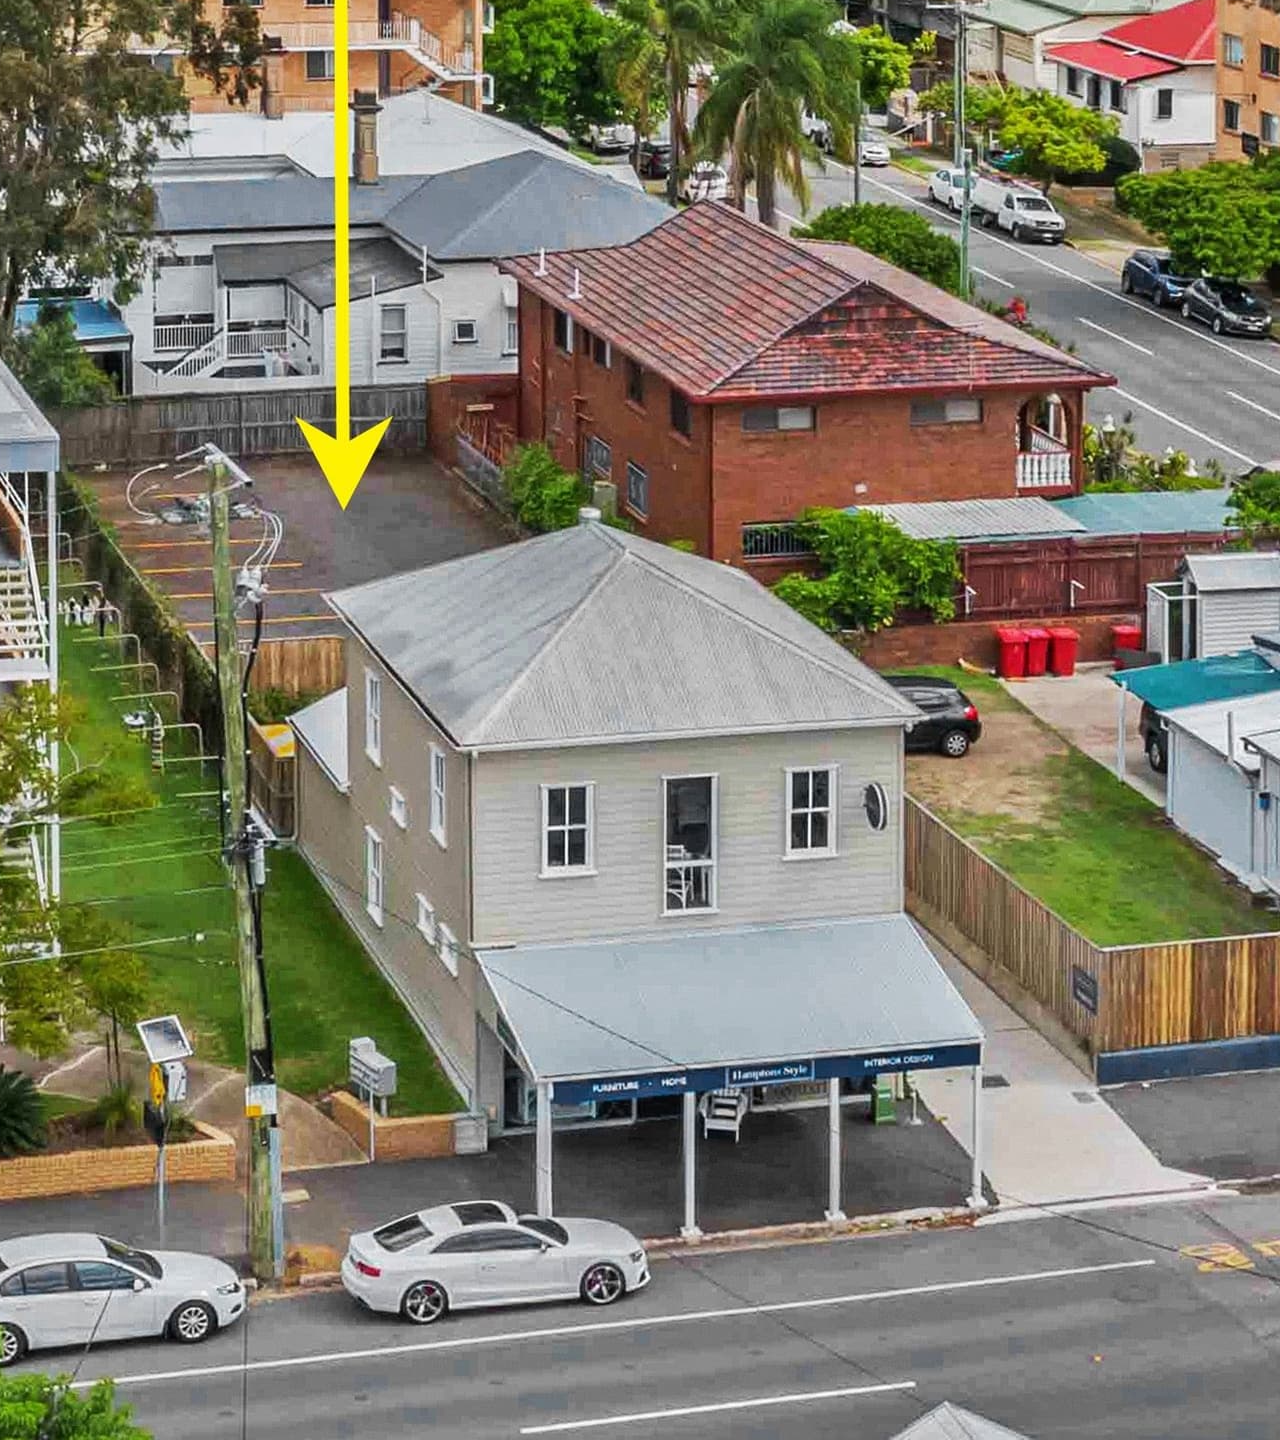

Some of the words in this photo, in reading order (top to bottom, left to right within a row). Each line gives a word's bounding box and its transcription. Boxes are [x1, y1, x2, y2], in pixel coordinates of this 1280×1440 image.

[864, 1057, 902, 1069] INTERIOR
[903, 1054, 934, 1065] DESIGN
[783, 1064, 808, 1078] Style
[592, 1081, 639, 1093] FURNITURE
[661, 1076, 687, 1087] HOME
